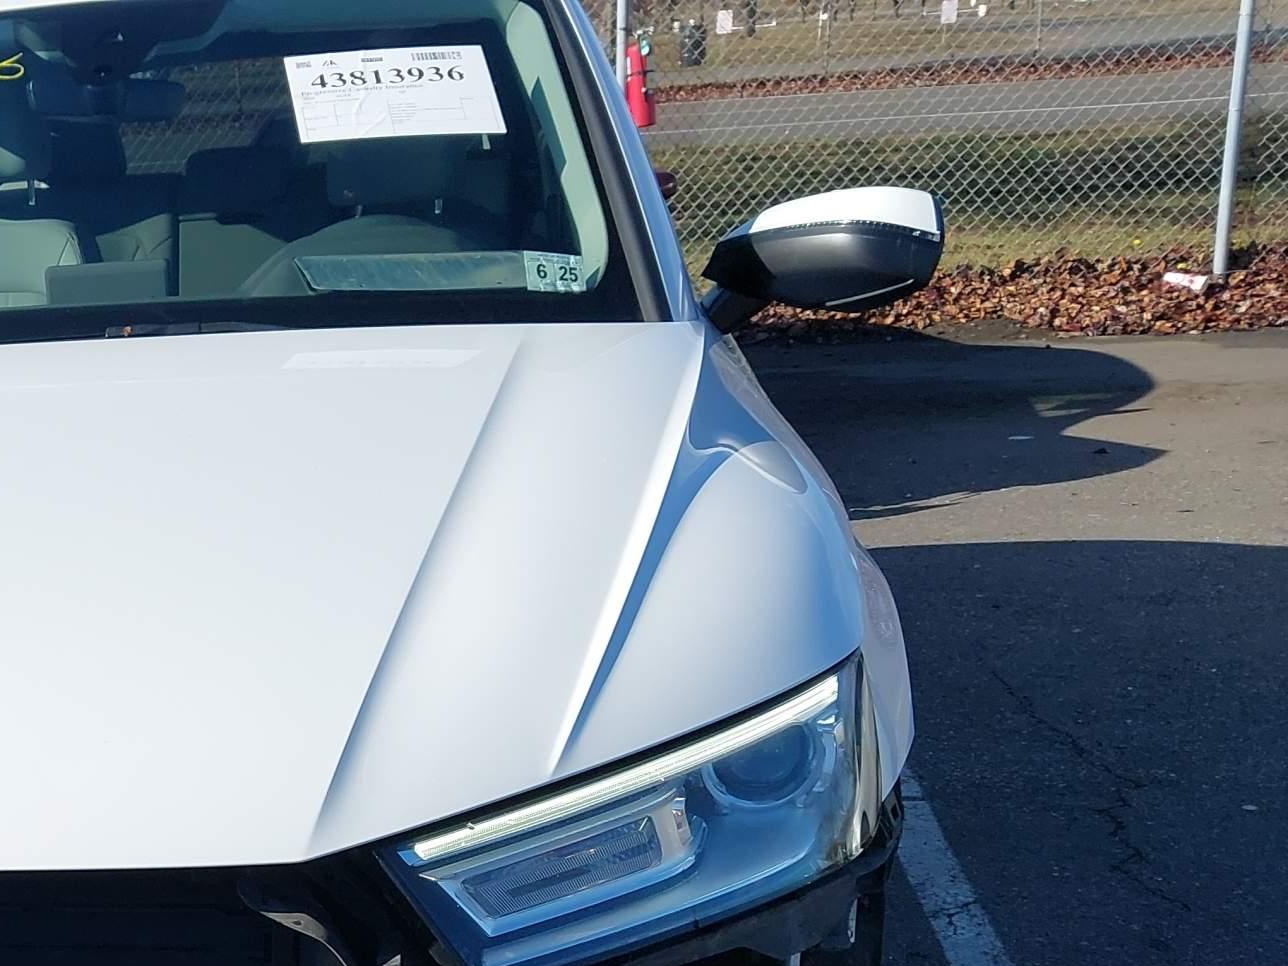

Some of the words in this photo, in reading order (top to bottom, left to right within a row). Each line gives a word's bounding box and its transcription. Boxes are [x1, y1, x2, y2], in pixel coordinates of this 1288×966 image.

[311, 65, 465, 89] 43813936
[536, 263, 548, 279] 6
[558, 265, 579, 283] 25
